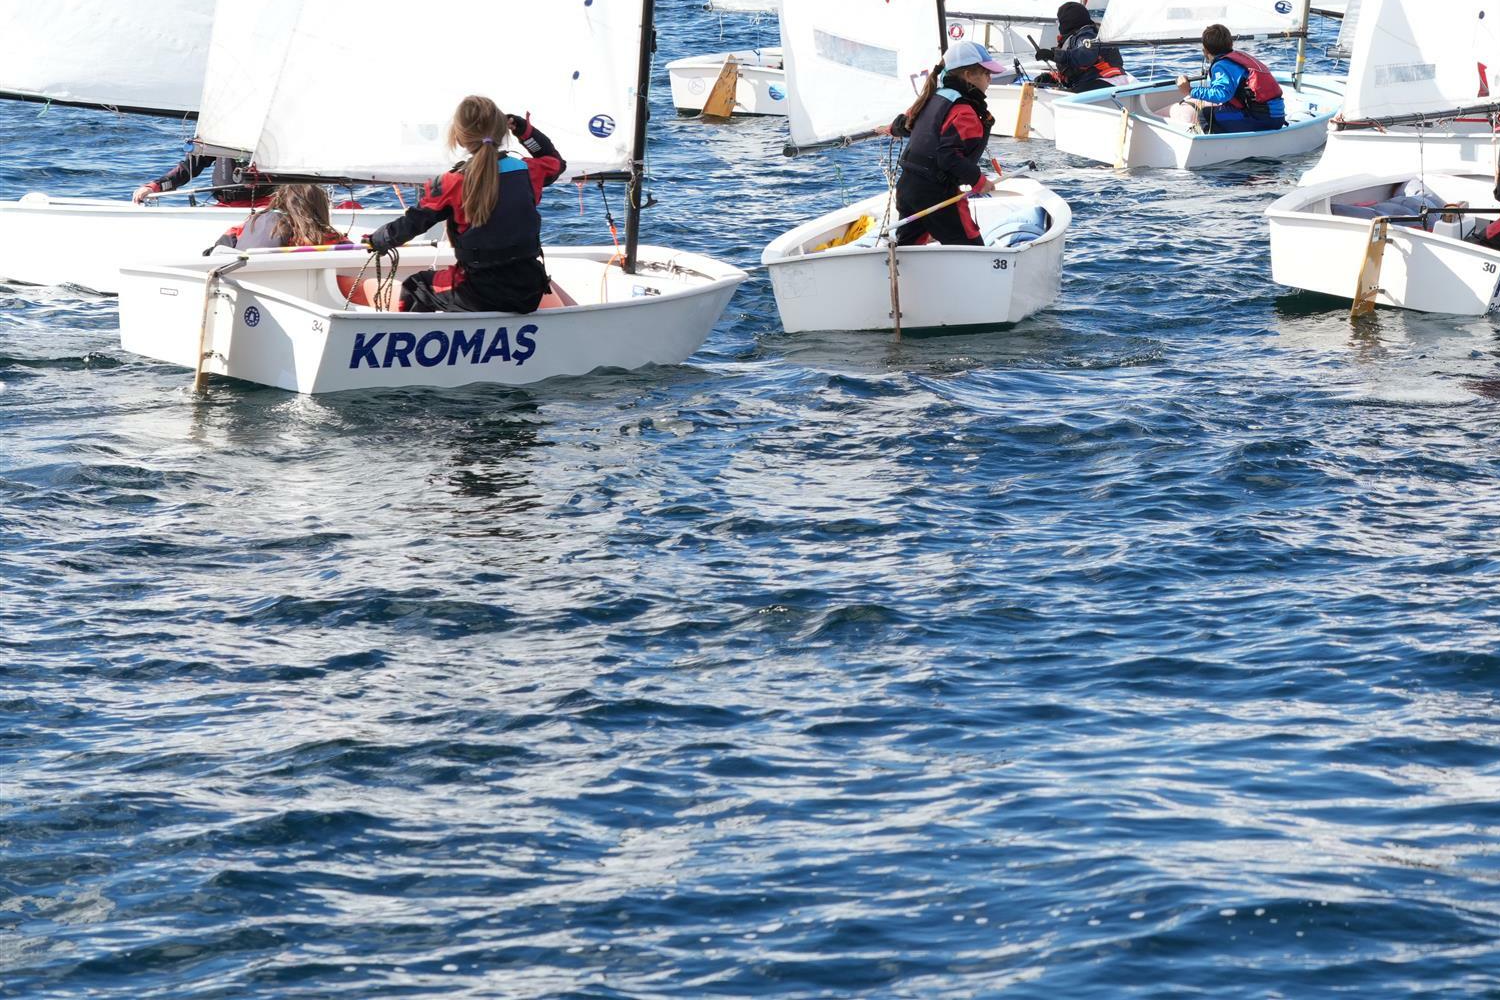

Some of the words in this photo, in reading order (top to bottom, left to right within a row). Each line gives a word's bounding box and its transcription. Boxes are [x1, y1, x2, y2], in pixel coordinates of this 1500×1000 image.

[993, 259, 1008, 270] 38
[1482, 261, 1497, 274] 30
[349, 324, 539, 370] KROMAŞ
